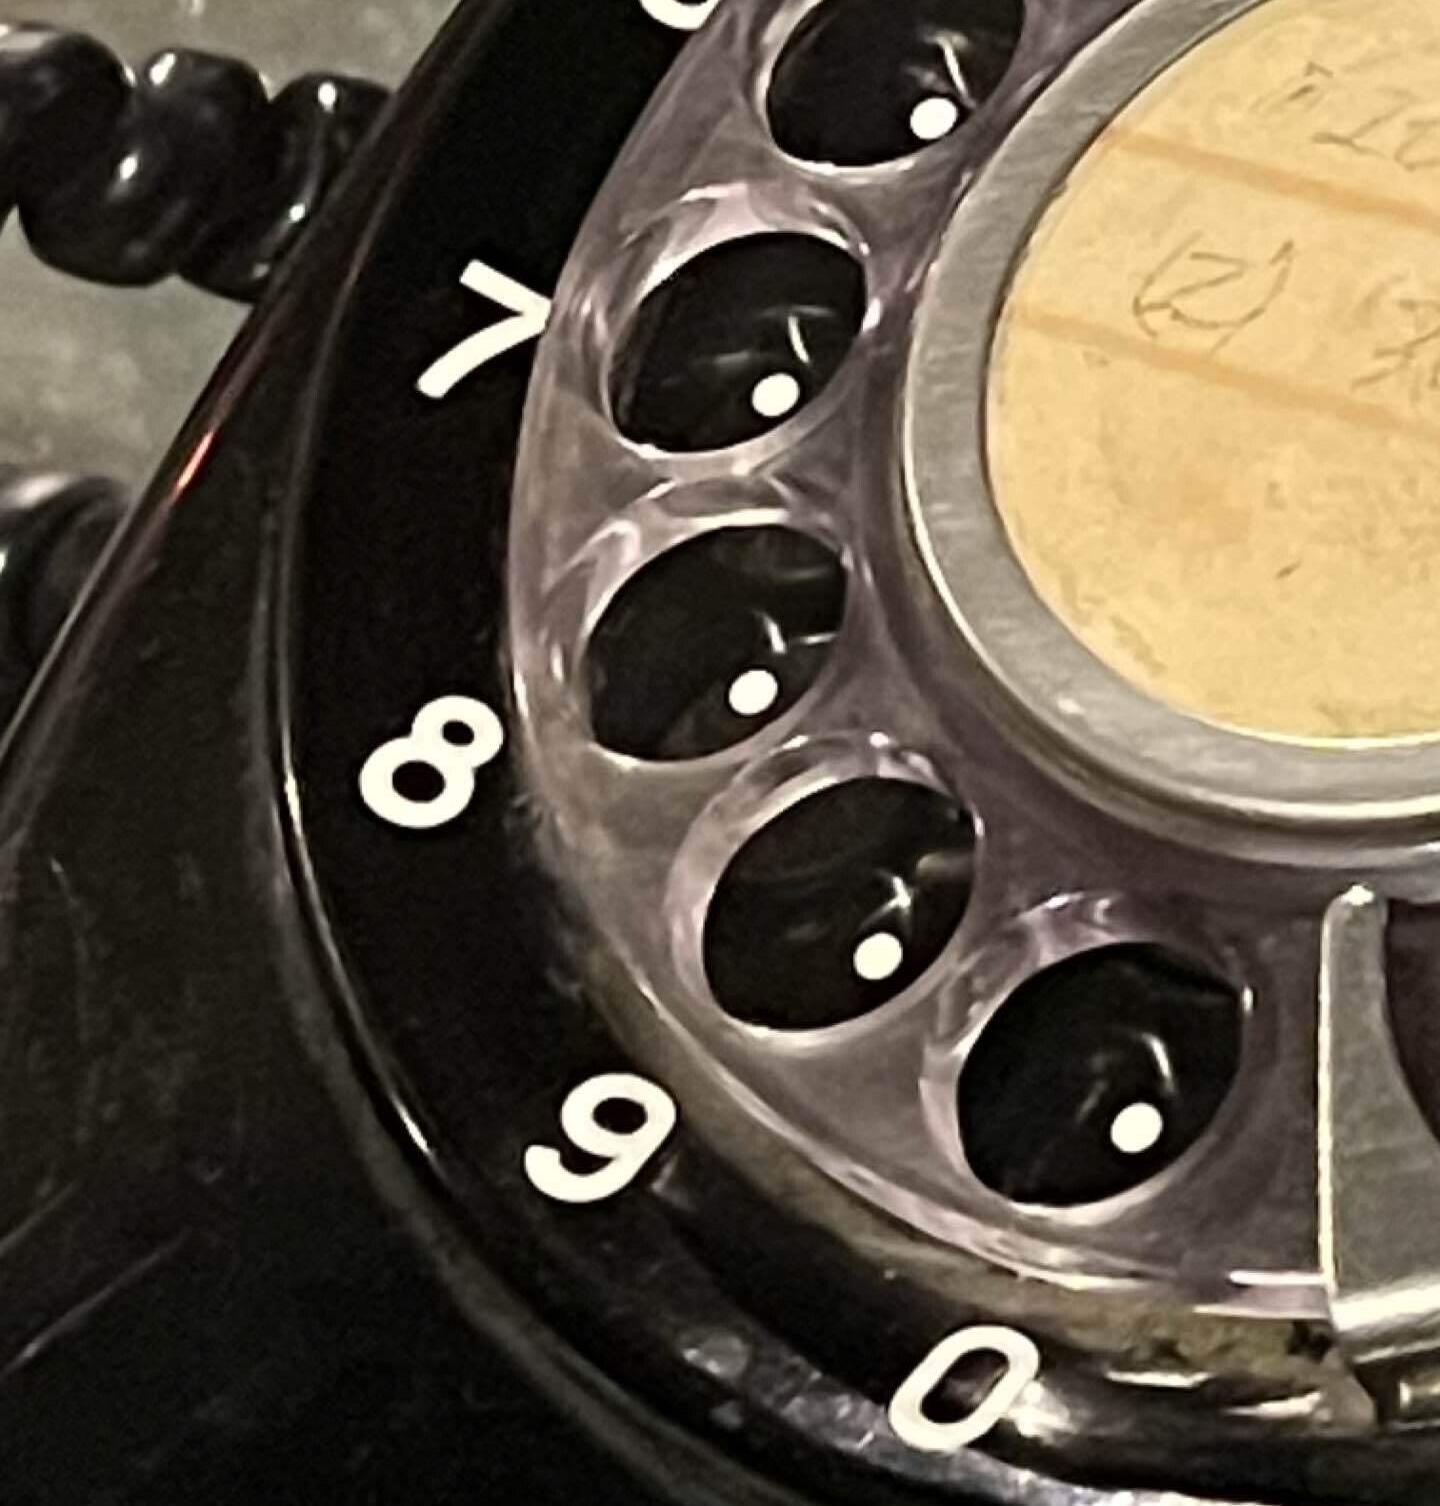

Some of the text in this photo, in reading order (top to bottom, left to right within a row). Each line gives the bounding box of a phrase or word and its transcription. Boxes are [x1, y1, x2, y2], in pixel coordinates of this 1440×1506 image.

[416, 259, 553, 399] 7
[359, 694, 505, 829] 8
[524, 1073, 676, 1204] 9
[887, 1324, 1041, 1455] 0
